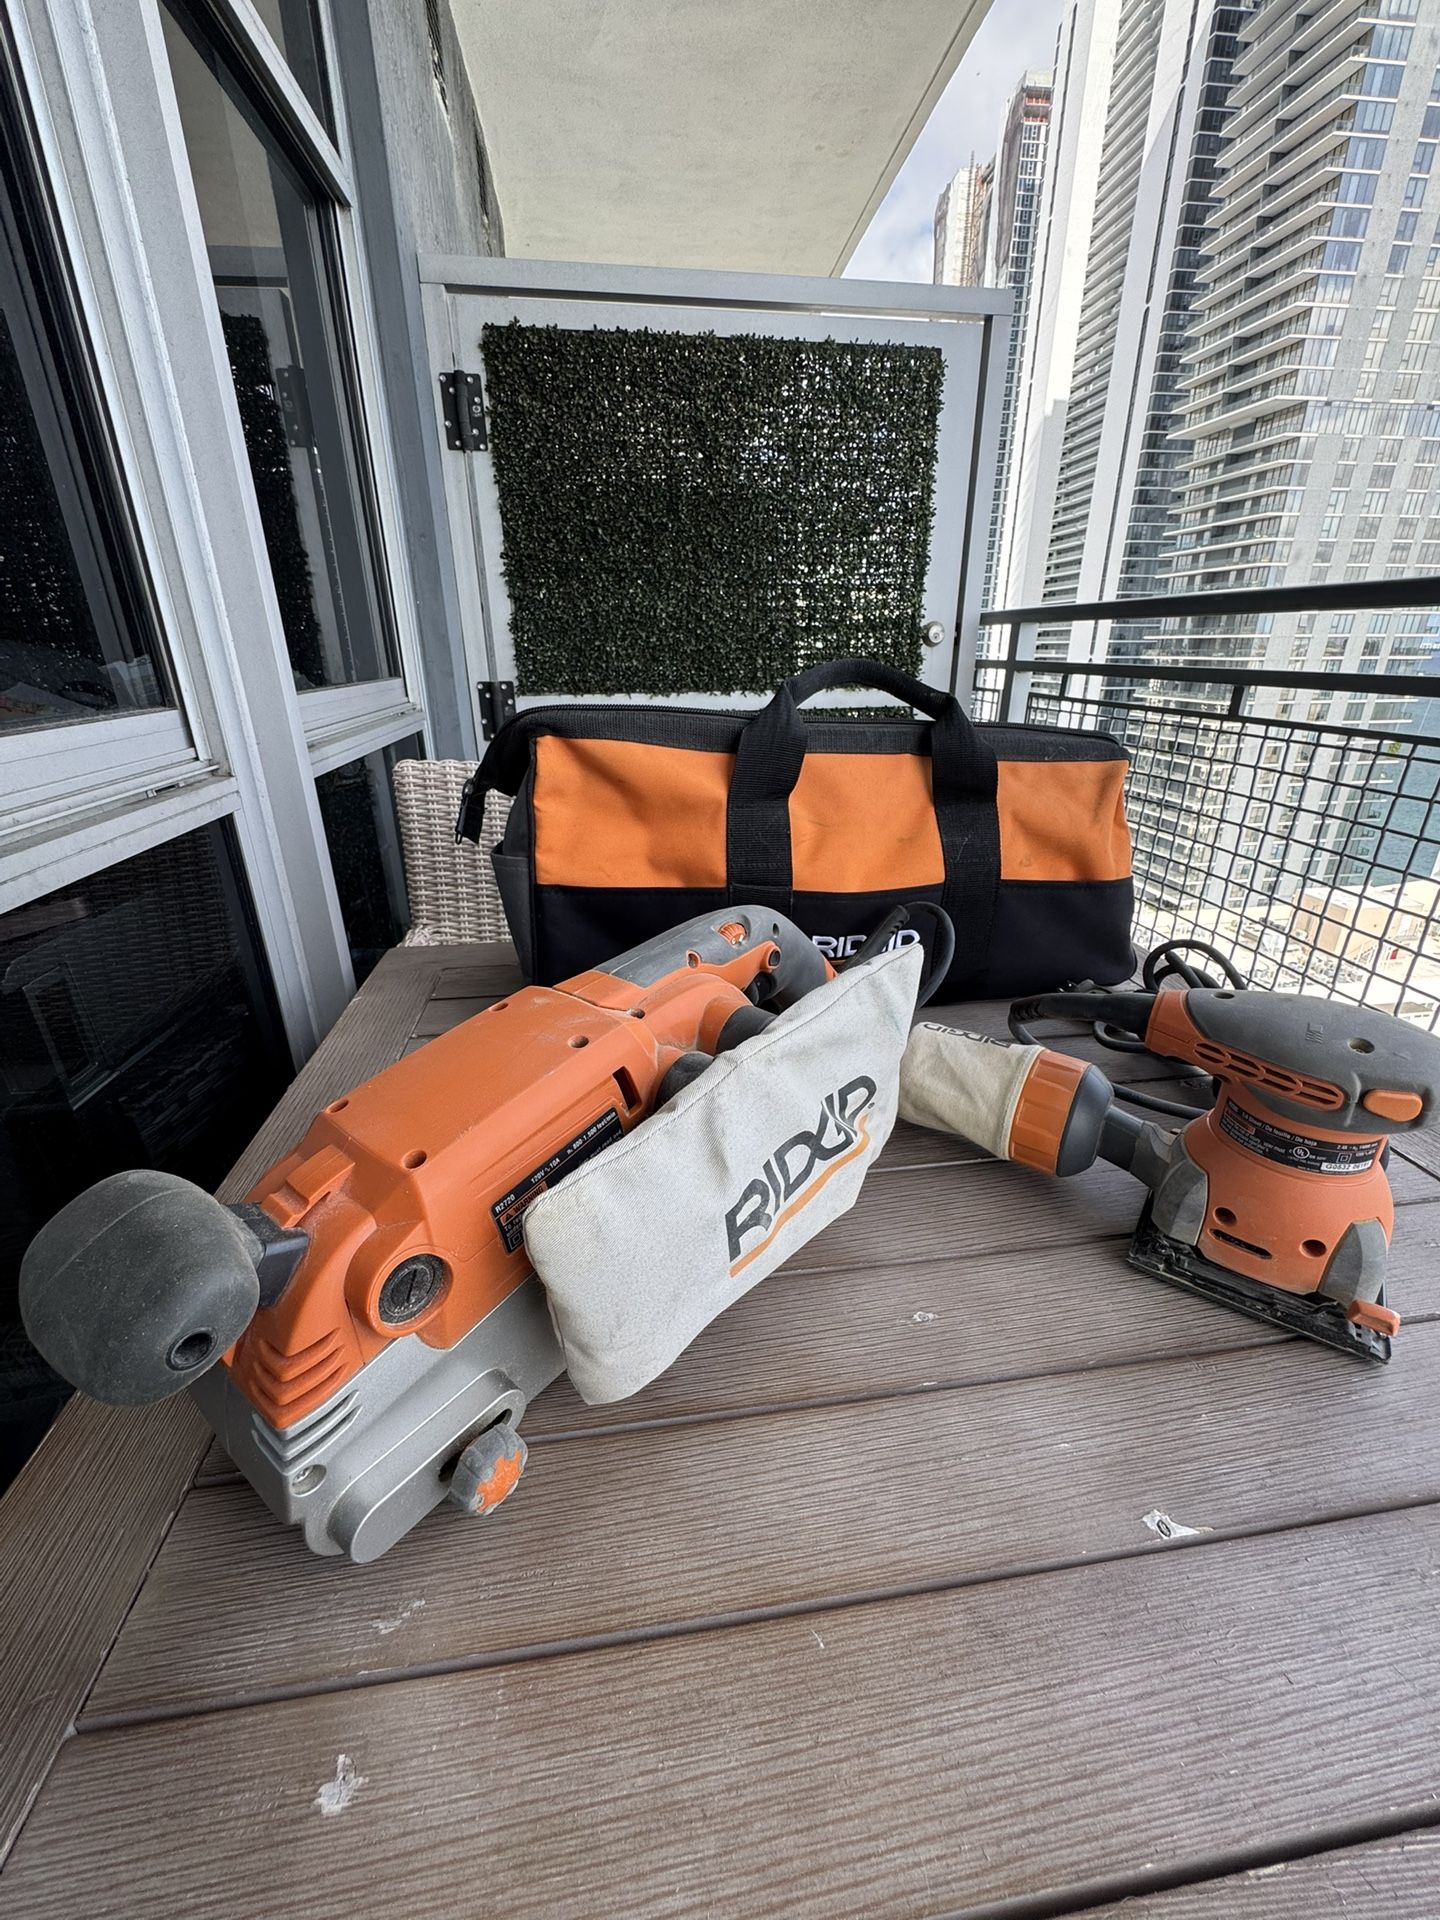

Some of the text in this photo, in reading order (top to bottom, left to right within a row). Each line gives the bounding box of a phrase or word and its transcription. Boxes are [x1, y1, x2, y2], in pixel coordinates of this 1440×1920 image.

[812, 929, 920, 957] RIDID
[725, 1075, 877, 1262] RIDGID
[494, 1193, 516, 1213] R2720
[531, 1169, 545, 1184] 120V
